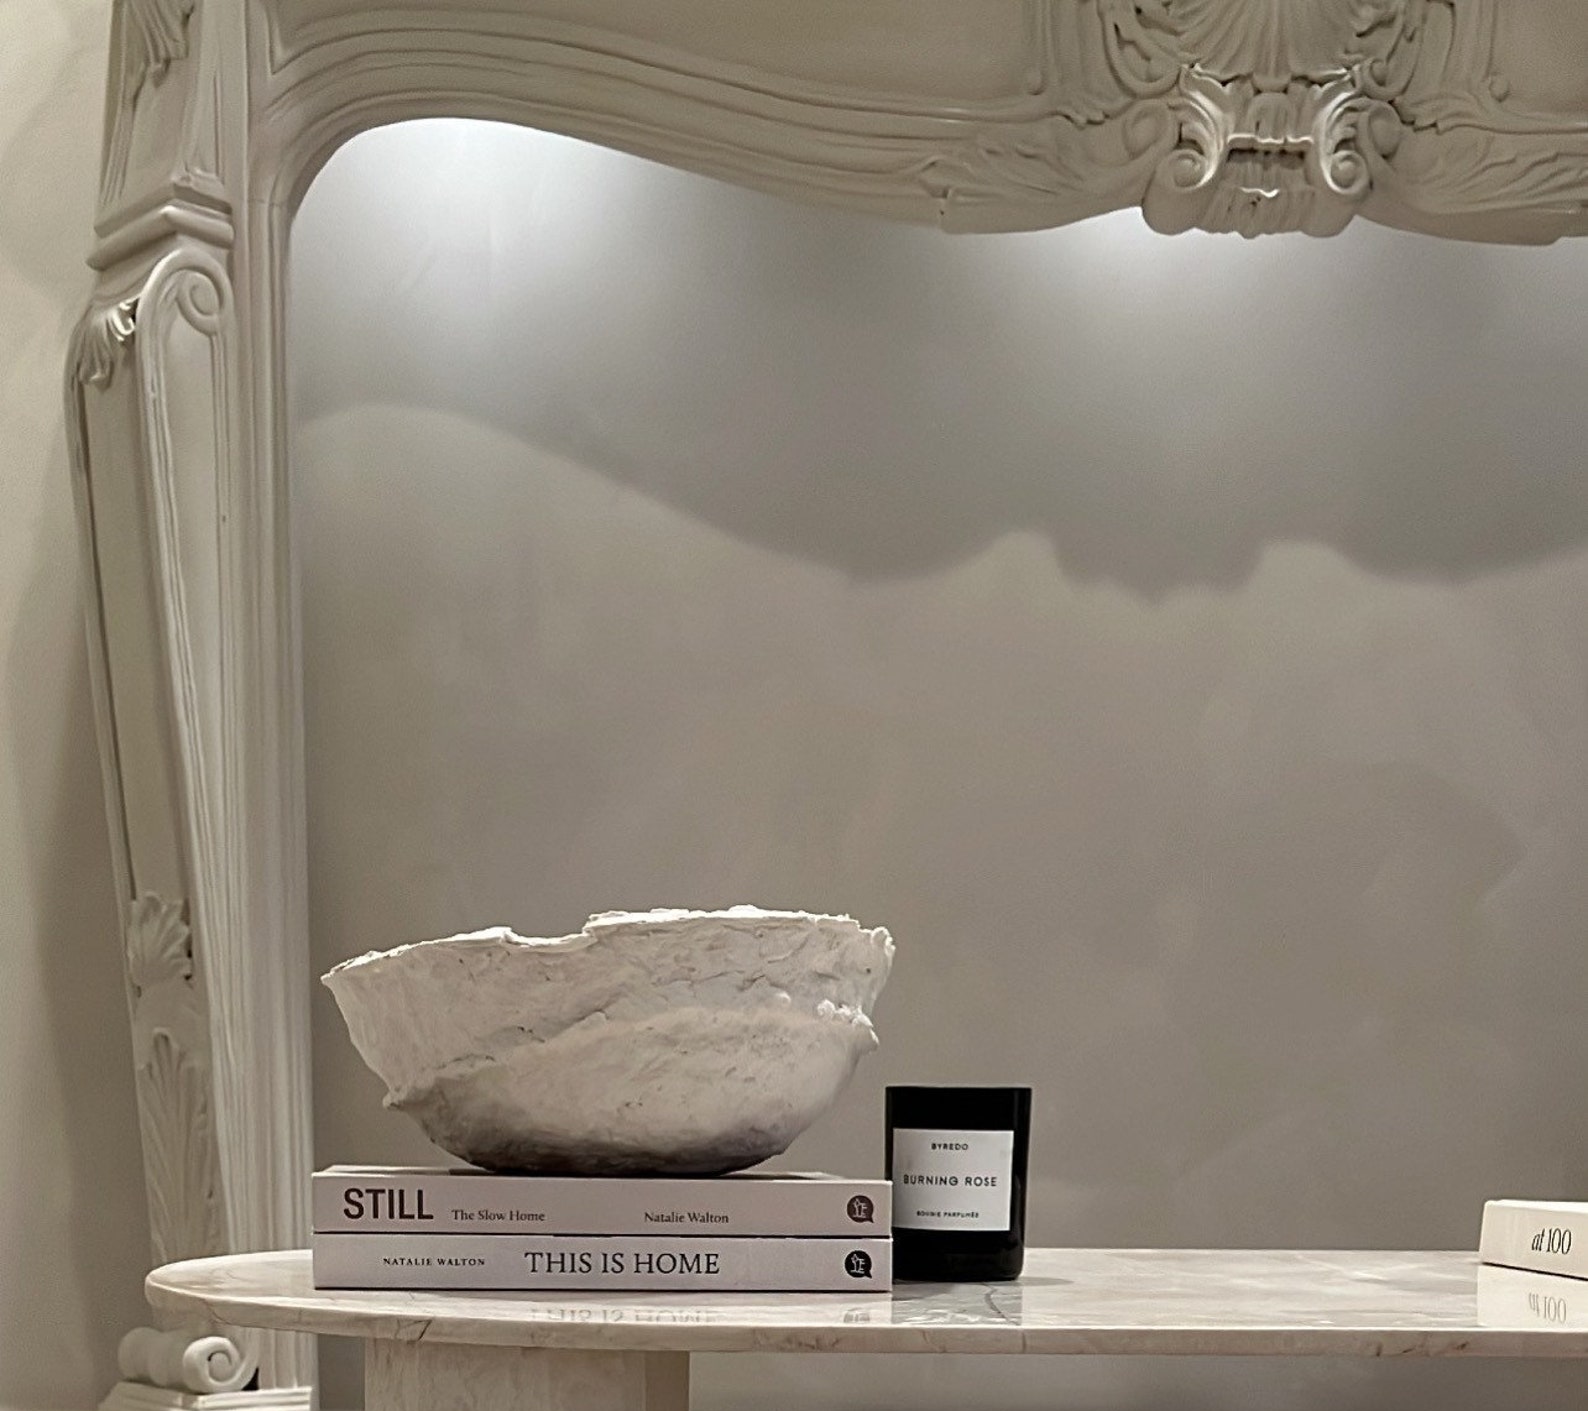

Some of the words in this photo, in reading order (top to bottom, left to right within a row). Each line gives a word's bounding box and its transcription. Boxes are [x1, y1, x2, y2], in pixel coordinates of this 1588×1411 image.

[931, 1143, 969, 1151] BYREDO
[903, 1174, 959, 1186] BURNING
[965, 1176, 998, 1187] ROSE
[343, 1188, 434, 1220] STILL
[451, 1209, 475, 1221] The
[478, 1209, 506, 1221] Slow
[509, 1210, 546, 1222] Home
[644, 1211, 686, 1223] Natalie
[687, 1212, 730, 1224] Walton
[1531, 1228, 1546, 1251] at
[1546, 1228, 1572, 1255] 100
[383, 1257, 433, 1266] NATALIE
[437, 1258, 485, 1266] WALTON
[524, 1252, 592, 1274] THIS
[601, 1253, 625, 1274] IS
[634, 1253, 720, 1275] HOME
